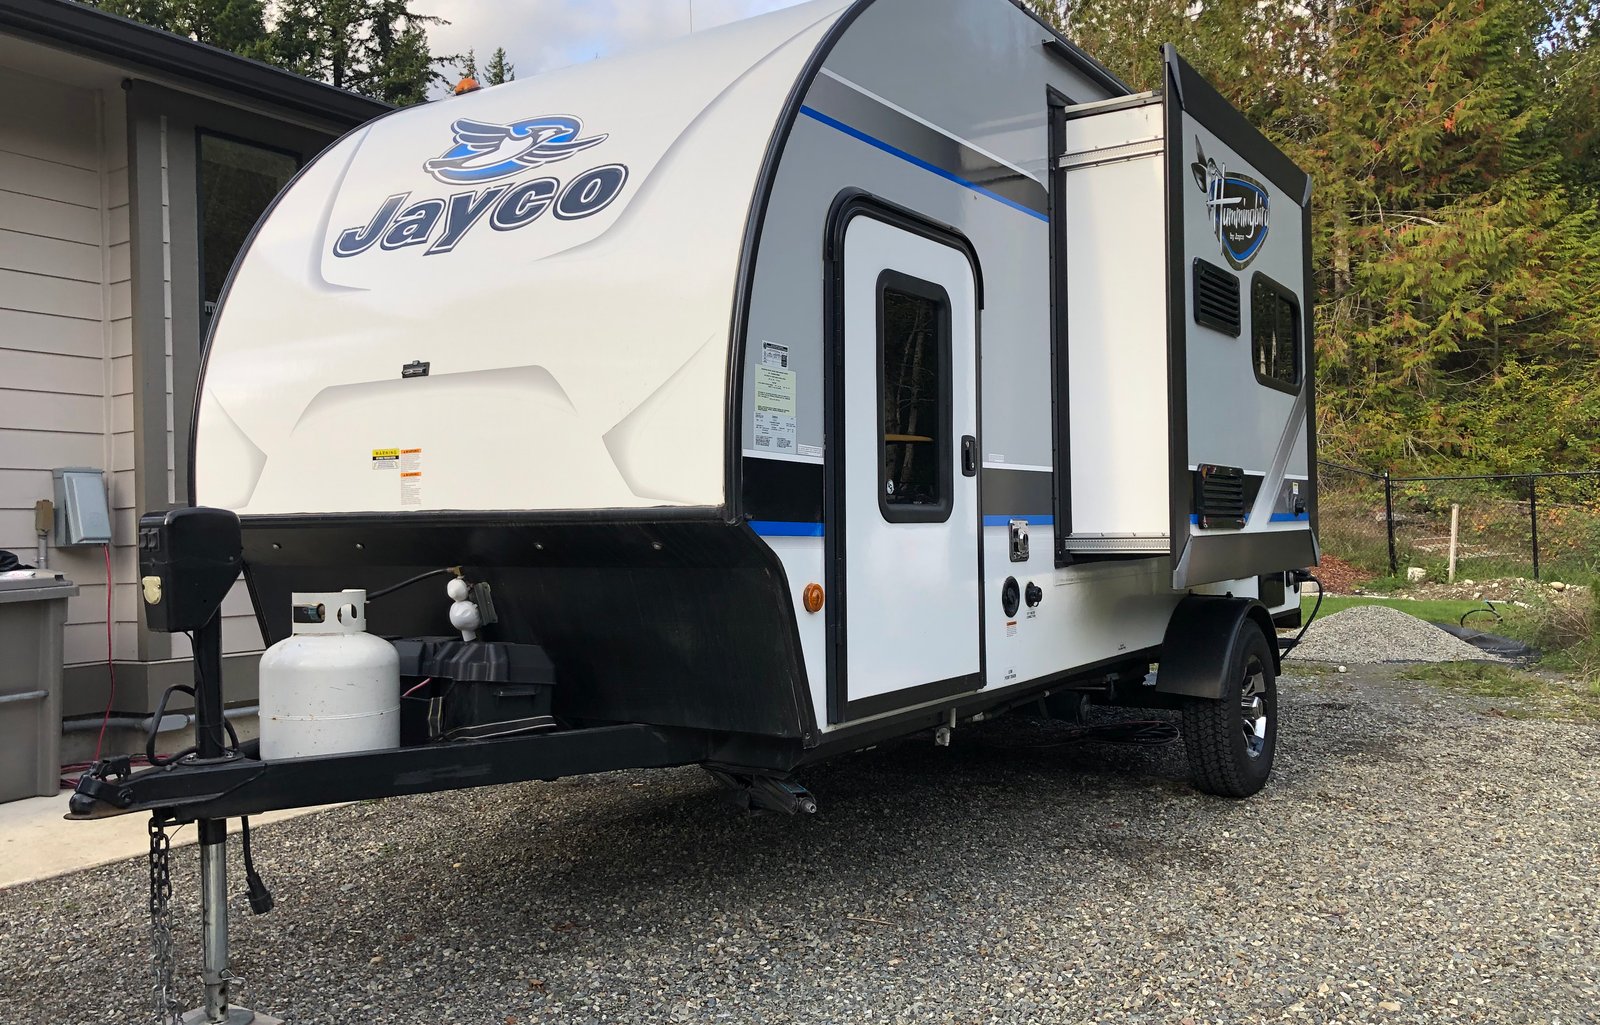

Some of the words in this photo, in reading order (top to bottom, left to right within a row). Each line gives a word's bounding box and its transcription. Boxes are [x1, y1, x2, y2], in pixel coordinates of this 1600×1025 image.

[333, 163, 629, 258] Jayco
[1206, 162, 1271, 256] Hummingbird
[1229, 232, 1234, 241] by
